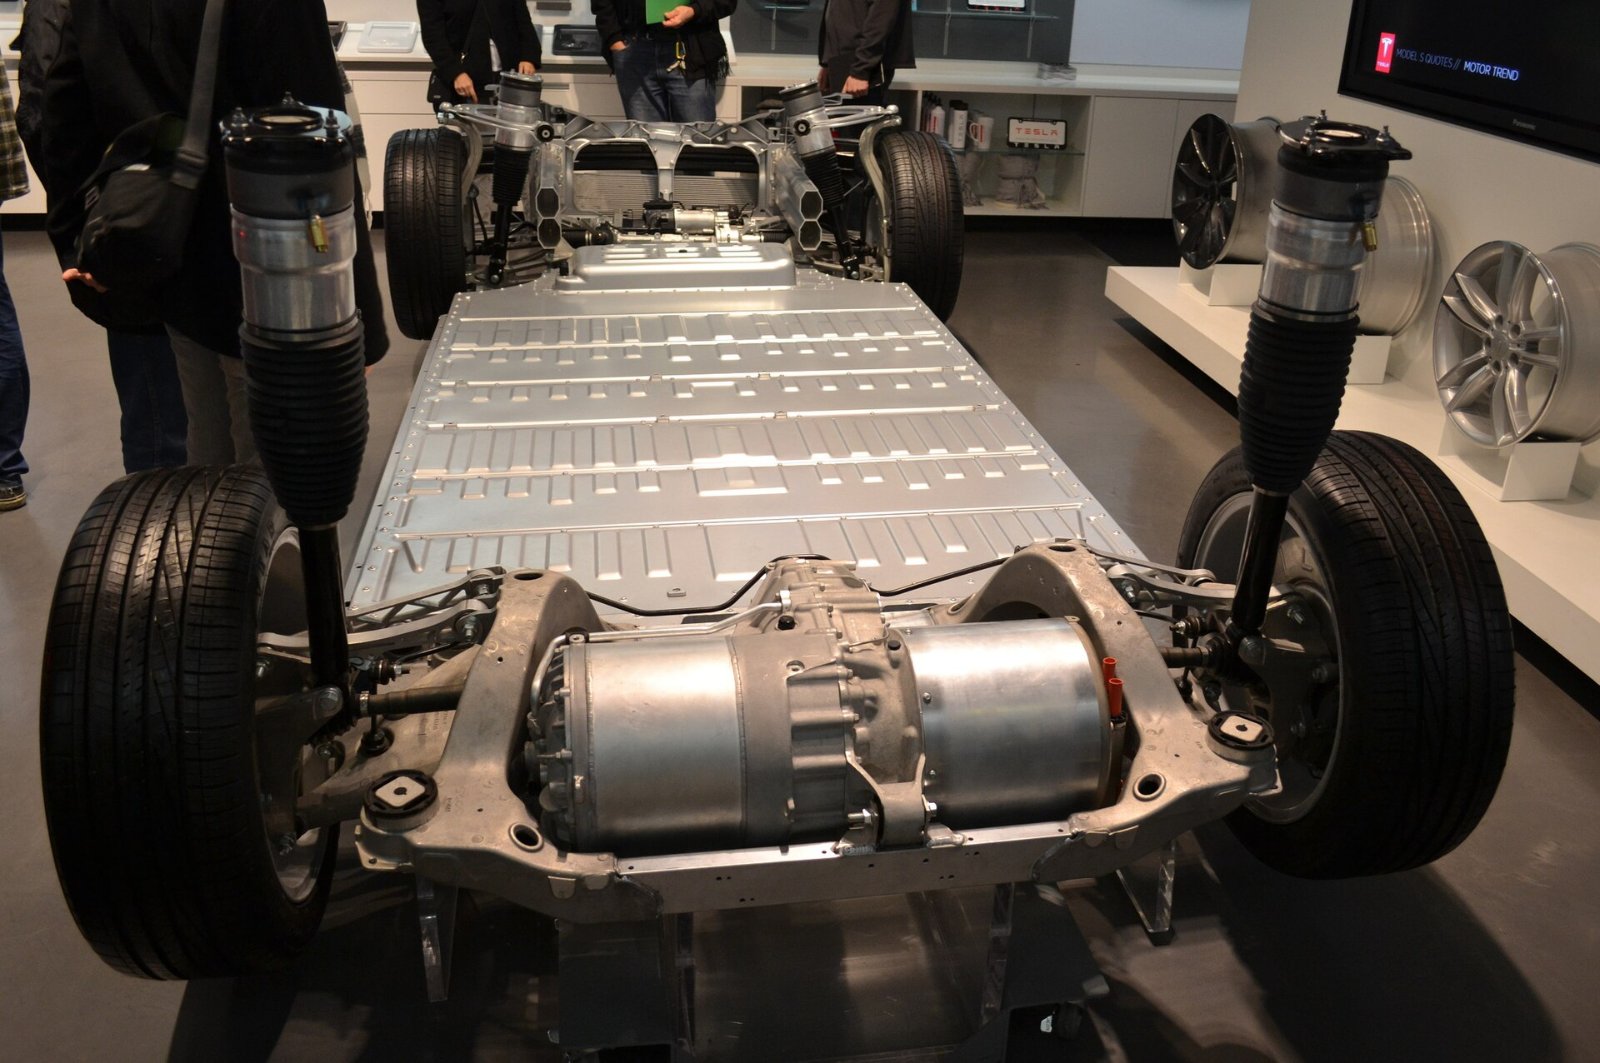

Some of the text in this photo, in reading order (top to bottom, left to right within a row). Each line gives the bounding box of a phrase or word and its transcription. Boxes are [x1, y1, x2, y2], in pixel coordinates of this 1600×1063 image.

[1396, 48, 1417, 61] MODEL
[1425, 53, 1453, 68] QUOTES
[1463, 60, 1491, 75] MOTOR
[1492, 66, 1519, 81] TREND
[1015, 127, 1058, 136] TESLA
